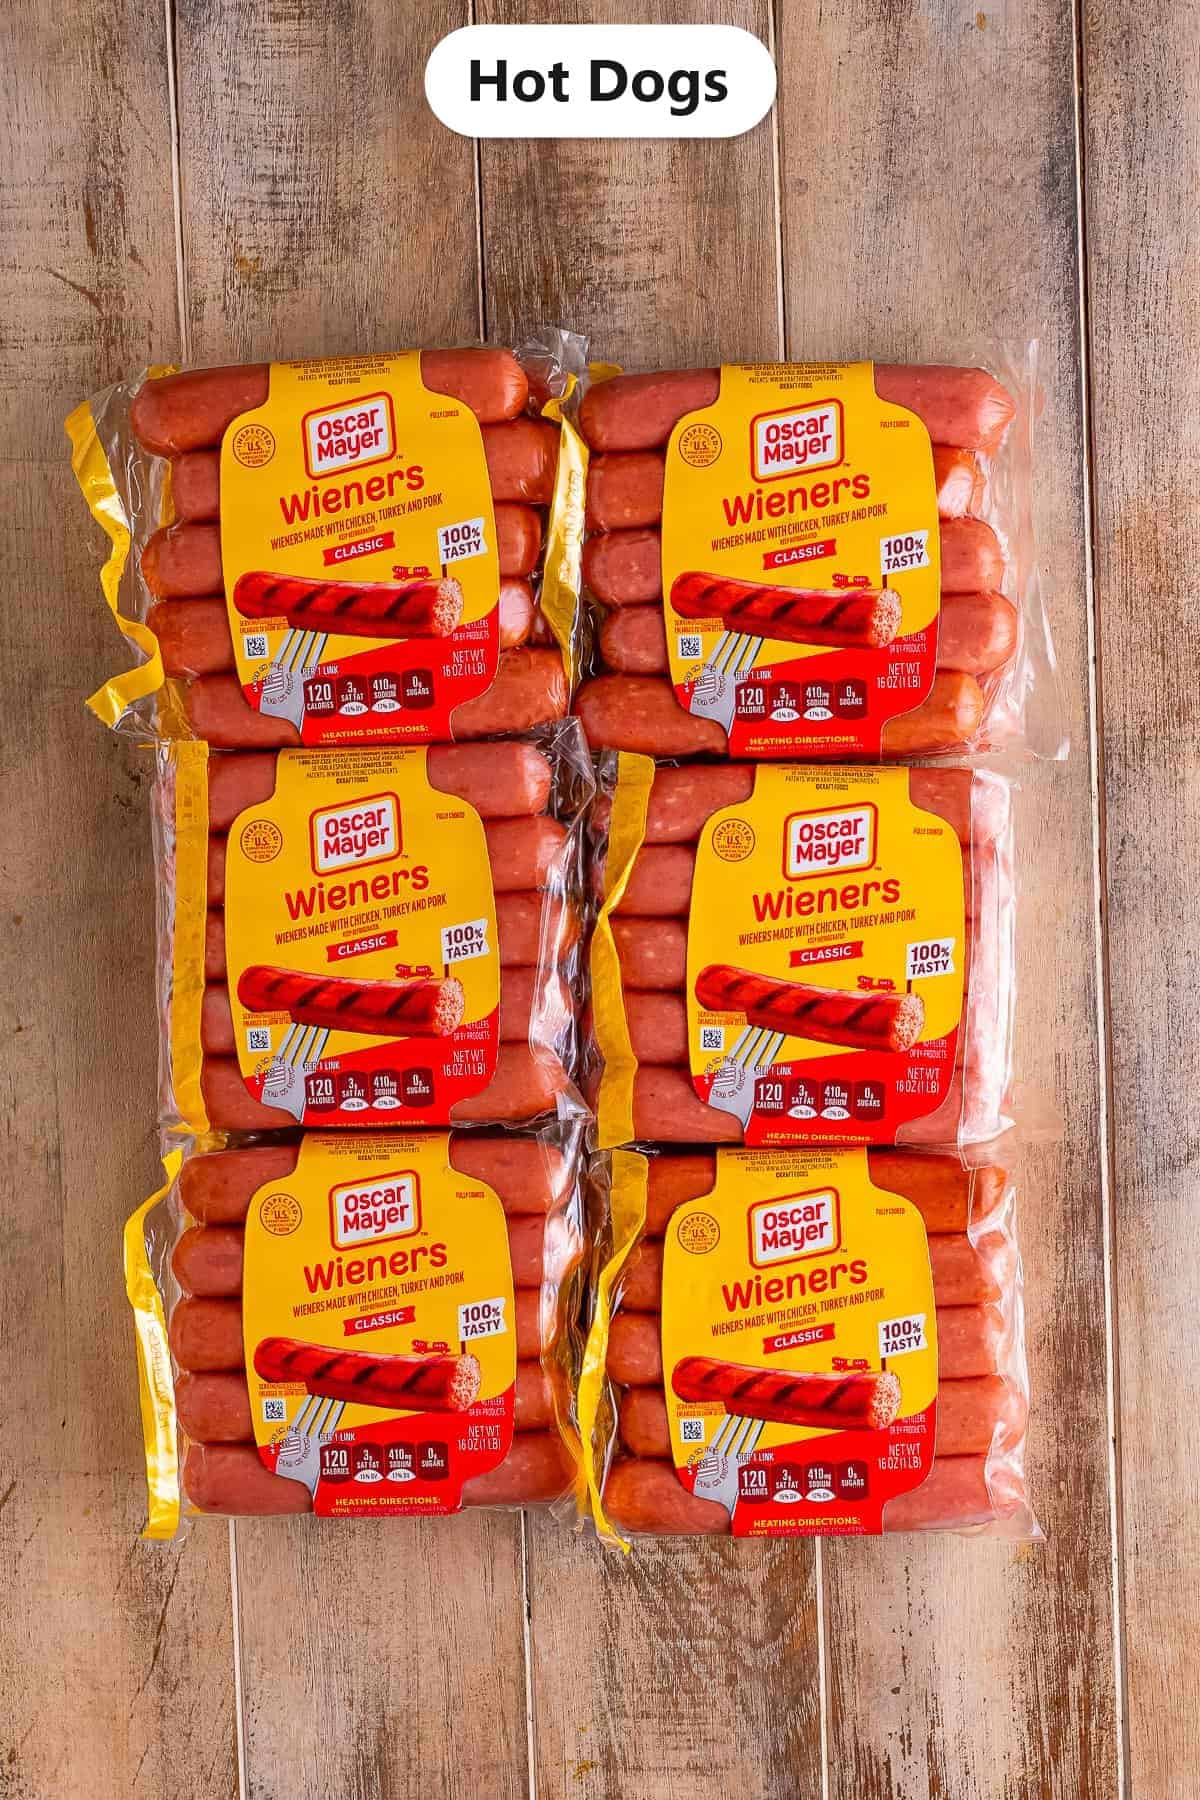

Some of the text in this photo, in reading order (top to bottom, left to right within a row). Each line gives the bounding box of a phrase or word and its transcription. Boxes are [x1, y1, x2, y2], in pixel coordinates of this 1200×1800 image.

[317, 408, 379, 440] Oscar
[765, 414, 829, 444] Oscar
[317, 428, 383, 461] Mayer
[764, 434, 832, 465] Mayer
[279, 465, 424, 525] Wieners
[722, 473, 870, 527] Wieners
[270, 532, 303, 550] WIENERS
[303, 526, 325, 542] MADE
[325, 520, 345, 535] WITH
[345, 512, 378, 530] CHICKEN,
[378, 505, 406, 521] TURKEY
[407, 498, 422, 514] AND
[422, 493, 443, 509] PORK
[711, 534, 743, 551] WIENERS
[745, 530, 766, 544] MADE
[767, 524, 787, 539] WITH
[787, 518, 820, 535] CHICKEN,
[821, 513, 850, 528] TURKEY
[851, 507, 866, 522] AND
[867, 503, 887, 518] PORK
[441, 524, 480, 545] 100%
[333, 537, 383, 559] CLASSIC
[442, 539, 481, 559] TASTY
[774, 544, 825, 563] CLASSIC
[884, 536, 923, 555] 100%
[884, 551, 924, 570] TASTY
[452, 648, 484, 663] NET WT
[442, 664, 451, 677] 16
[452, 663, 463, 676] OZ
[888, 661, 920, 675] NET WT
[876, 676, 885, 689] 16
[886, 676, 898, 688] OZ
[307, 683, 331, 702] 120
[739, 687, 763, 705] 120
[306, 701, 335, 710] CALORIES
[737, 706, 765, 714] CALORIES
[322, 729, 364, 739] HEATING
[750, 737, 792, 745] HEATING
[324, 807, 386, 838] Oscar
[798, 817, 863, 843] Oscar
[323, 827, 389, 858] Mayer
[796, 837, 865, 865] Mayer
[285, 865, 429, 920] Wieners
[752, 878, 900, 922] Wieners
[275, 927, 307, 945] WIENERS
[308, 923, 329, 938] MADE
[329, 917, 349, 931] WITH
[349, 910, 382, 927] CHICKEN,
[382, 904, 410, 919] TURKEY
[411, 898, 426, 913] AND
[426, 893, 446, 909] PORK
[738, 931, 771, 945] WIENERS
[773, 928, 793, 941] MADE
[795, 924, 815, 937] WITH
[815, 920, 848, 935] CHICKEN,
[849, 916, 878, 929] TURKEY
[879, 912, 894, 926] AND
[895, 908, 915, 923] PORK
[444, 925, 483, 945] 100%
[337, 935, 387, 955] CLASSIC
[445, 940, 484, 959] TASTY
[800, 945, 851, 962] CLASSIC
[910, 943, 949, 961] 100%
[910, 959, 949, 975] TASTY
[452, 1049, 484, 1063] NET WT
[442, 1064, 451, 1076] 16
[452, 1063, 463, 1076] OZ
[907, 1067, 939, 1080] NET WT
[308, 1078, 332, 1096] 120
[758, 1083, 781, 1100] 120
[895, 1079, 903, 1092] 16
[905, 1080, 916, 1092] OZ
[307, 1096, 335, 1105] CALORIES
[755, 1101, 783, 1109] CALORIES
[767, 1133, 809, 1141] HEATING
[343, 1185, 406, 1213] Oscar
[343, 1204, 409, 1233] Mayer
[762, 1202, 825, 1231] Oscar
[761, 1221, 828, 1251] Mayer
[303, 1243, 447, 1293] Wieners
[292, 1301, 324, 1317] WIENERS
[326, 1297, 346, 1311] MADE
[347, 1292, 367, 1305] WITH
[367, 1286, 400, 1302] CHICKEN,
[400, 1281, 428, 1295] TURKEY
[429, 1275, 444, 1290] AND
[444, 1271, 464, 1286] PORK
[721, 1259, 867, 1312] Wieners
[354, 1311, 404, 1329] CLASSIC
[462, 1303, 500, 1322] 100%
[711, 1319, 743, 1336] WIENERS
[744, 1315, 765, 1329] MADE
[766, 1310, 786, 1324] WITH
[786, 1303, 819, 1320] CHICKEN,
[819, 1297, 847, 1312] TURKEY
[849, 1292, 864, 1307] AND
[864, 1287, 884, 1303] PORK
[462, 1318, 501, 1336] TASTY
[882, 1320, 921, 1339] 100%
[773, 1328, 824, 1348] CLASSIC
[882, 1334, 921, 1353] TASTY
[468, 1425, 499, 1438] NET WT
[457, 1438, 465, 1451] 16
[466, 1438, 478, 1450] OZ
[888, 1442, 920, 1456] NET WT
[323, 1450, 347, 1467] 120
[877, 1457, 886, 1470] 16
[887, 1457, 899, 1469] OZ
[321, 1467, 349, 1475] CALORIES
[741, 1469, 765, 1487] 120
[740, 1487, 768, 1496] CALORIES
[754, 1519, 797, 1527] HEATING
